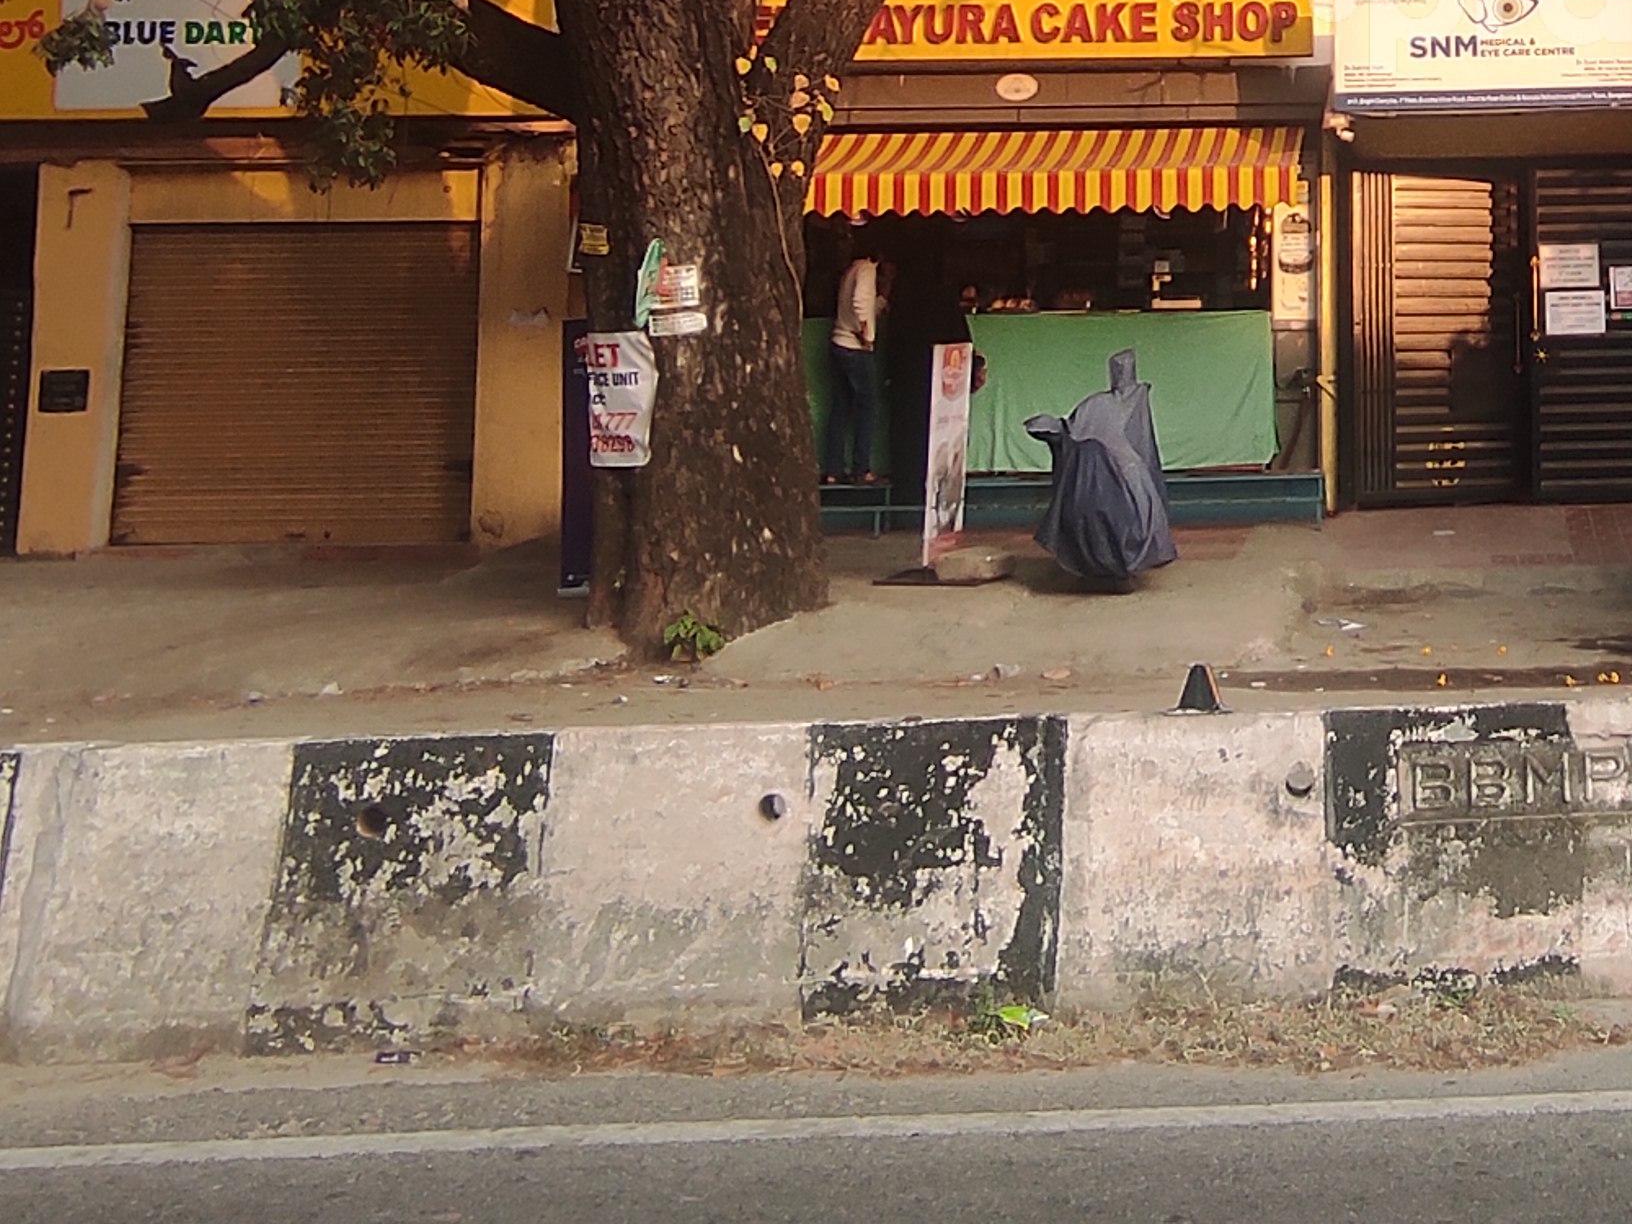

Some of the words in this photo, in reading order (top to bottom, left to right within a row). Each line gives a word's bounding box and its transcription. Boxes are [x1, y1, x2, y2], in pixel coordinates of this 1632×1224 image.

[104, 20, 177, 45] BLUE
[866, 3, 1021, 44] AYURA
[1031, 2, 1158, 43] CAKE
[1171, 1, 1298, 43] SHOP
[1409, 35, 1480, 59] SNM
[1480, 38, 1526, 47] MEDICAL
[1480, 48, 1500, 58] EYE
[1503, 47, 1532, 57] CARE
[1534, 46, 1576, 56] CENTRE
[612, 371, 639, 386] UNIT
[1414, 745, 1627, 810] BBMP
